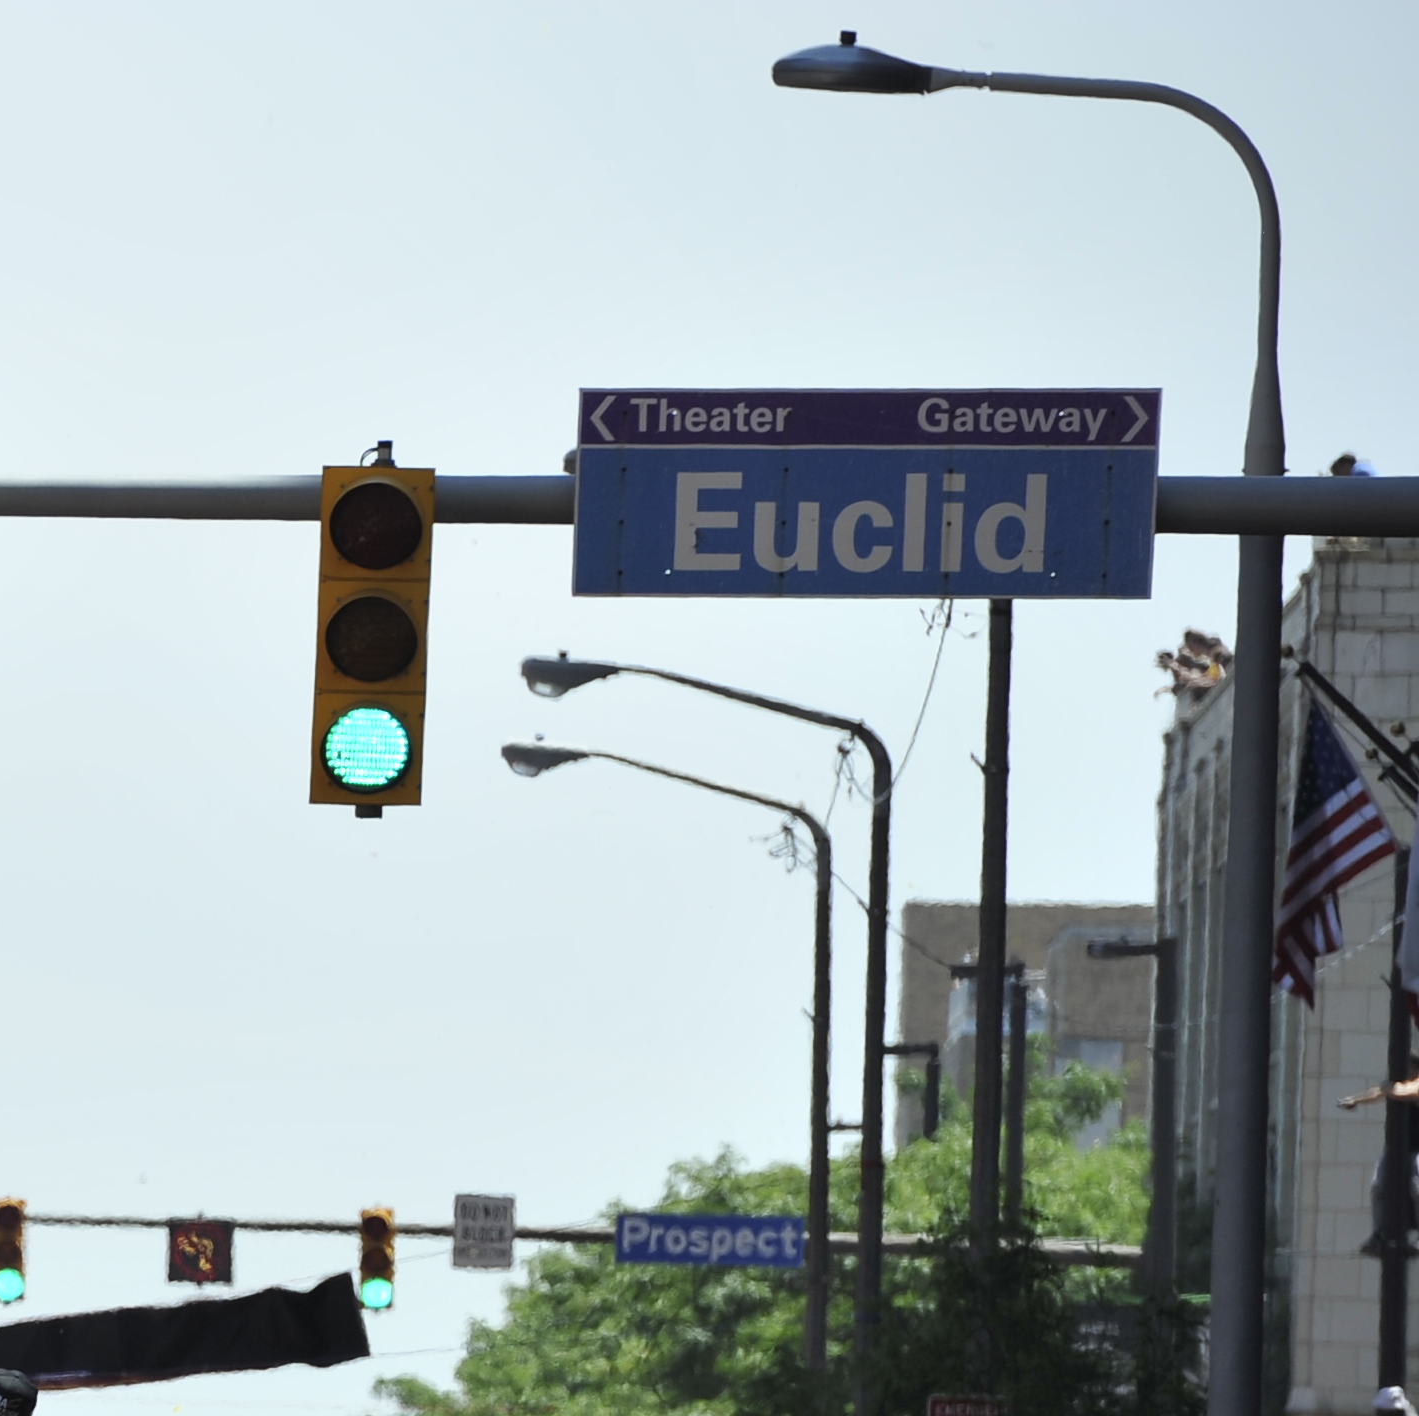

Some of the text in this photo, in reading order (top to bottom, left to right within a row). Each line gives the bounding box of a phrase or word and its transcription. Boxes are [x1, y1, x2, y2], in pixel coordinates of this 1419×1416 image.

[630, 396, 1107, 442] Theater Gateway
[672, 471, 1048, 575] Euclid
[621, 1217, 799, 1263] Prospect
